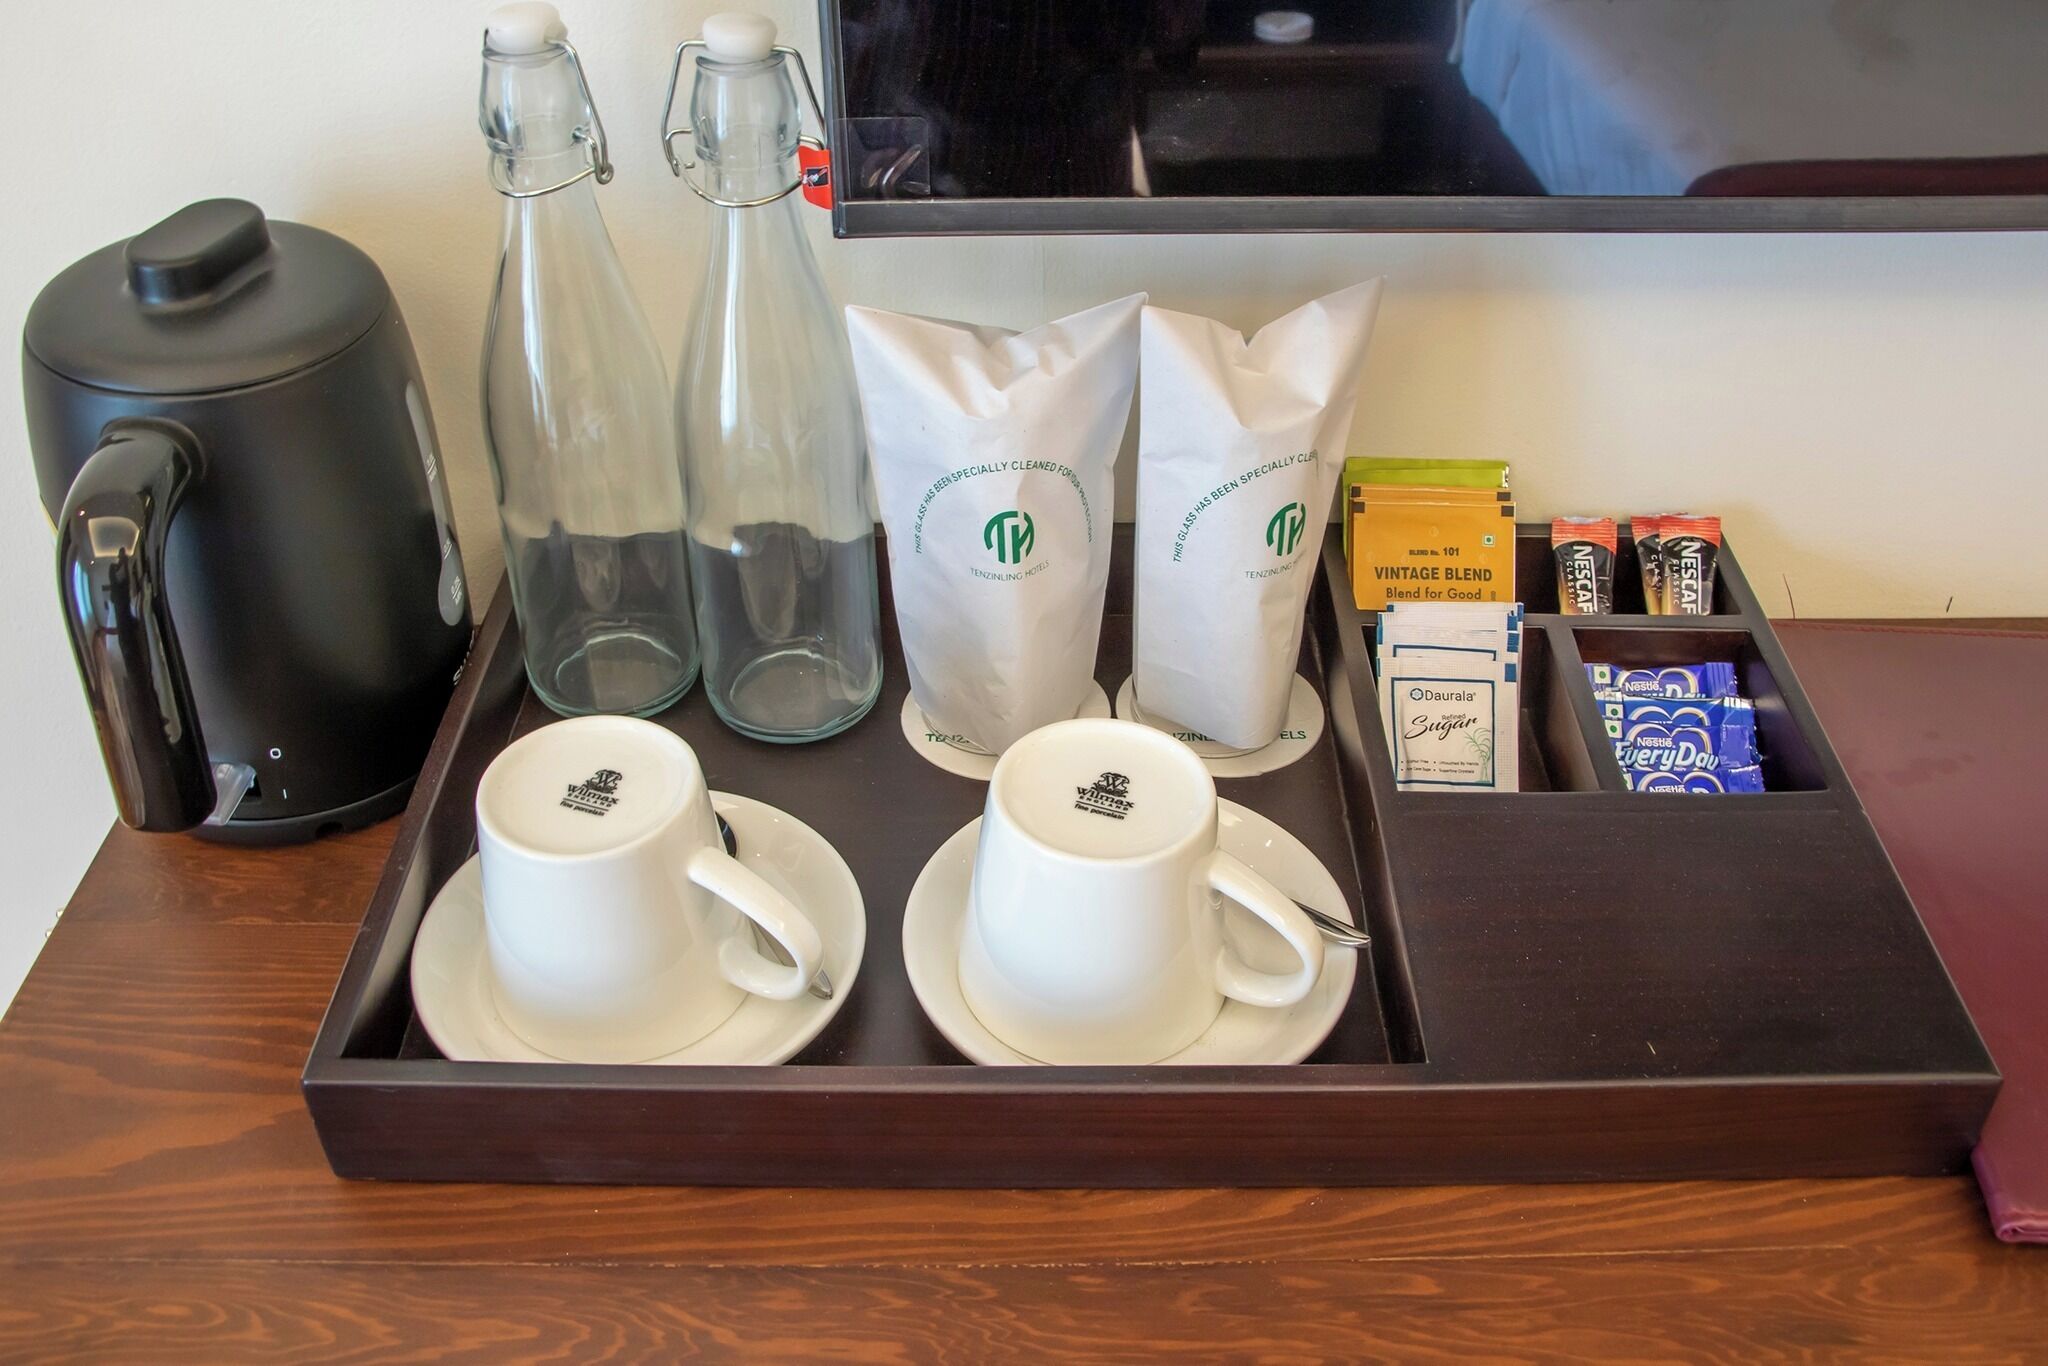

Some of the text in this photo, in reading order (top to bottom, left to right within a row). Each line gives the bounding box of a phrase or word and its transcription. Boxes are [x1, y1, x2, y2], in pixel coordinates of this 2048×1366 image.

[1240, 455, 1295, 484] SPECIALLY
[914, 504, 928, 534] GLASS
[925, 491, 936, 505] HAS
[933, 475, 952, 493] BEEN
[951, 462, 1009, 482] SPECIALLY
[1011, 460, 1057, 472] CLEANED
[1057, 465, 1073, 479] FOR
[1210, 479, 1239, 501] BEEN
[1194, 496, 1212, 514] HAS
[1177, 512, 1197, 541] GLASS
[1173, 541, 1183, 563] THIS
[1443, 547, 1460, 556] 101
[970, 560, 1050, 582] TENZINLING HOTELS
[1245, 561, 1293, 579] TENZINLING
[1375, 566, 1493, 582] VINTAGE BLEND
[1386, 586, 1420, 599] Blend
[1425, 587, 1442, 599] for
[1447, 588, 1481, 600] Good
[1566, 561, 1576, 605] CLASSIC
[1425, 690, 1474, 701] Daurala
[1404, 715, 1477, 740] Sugar
[1637, 736, 1673, 747] Nestlé
[567, 784, 619, 804] Wilmax
[1077, 786, 1135, 808] Wilmax
[1090, 808, 1125, 820] porcelain
